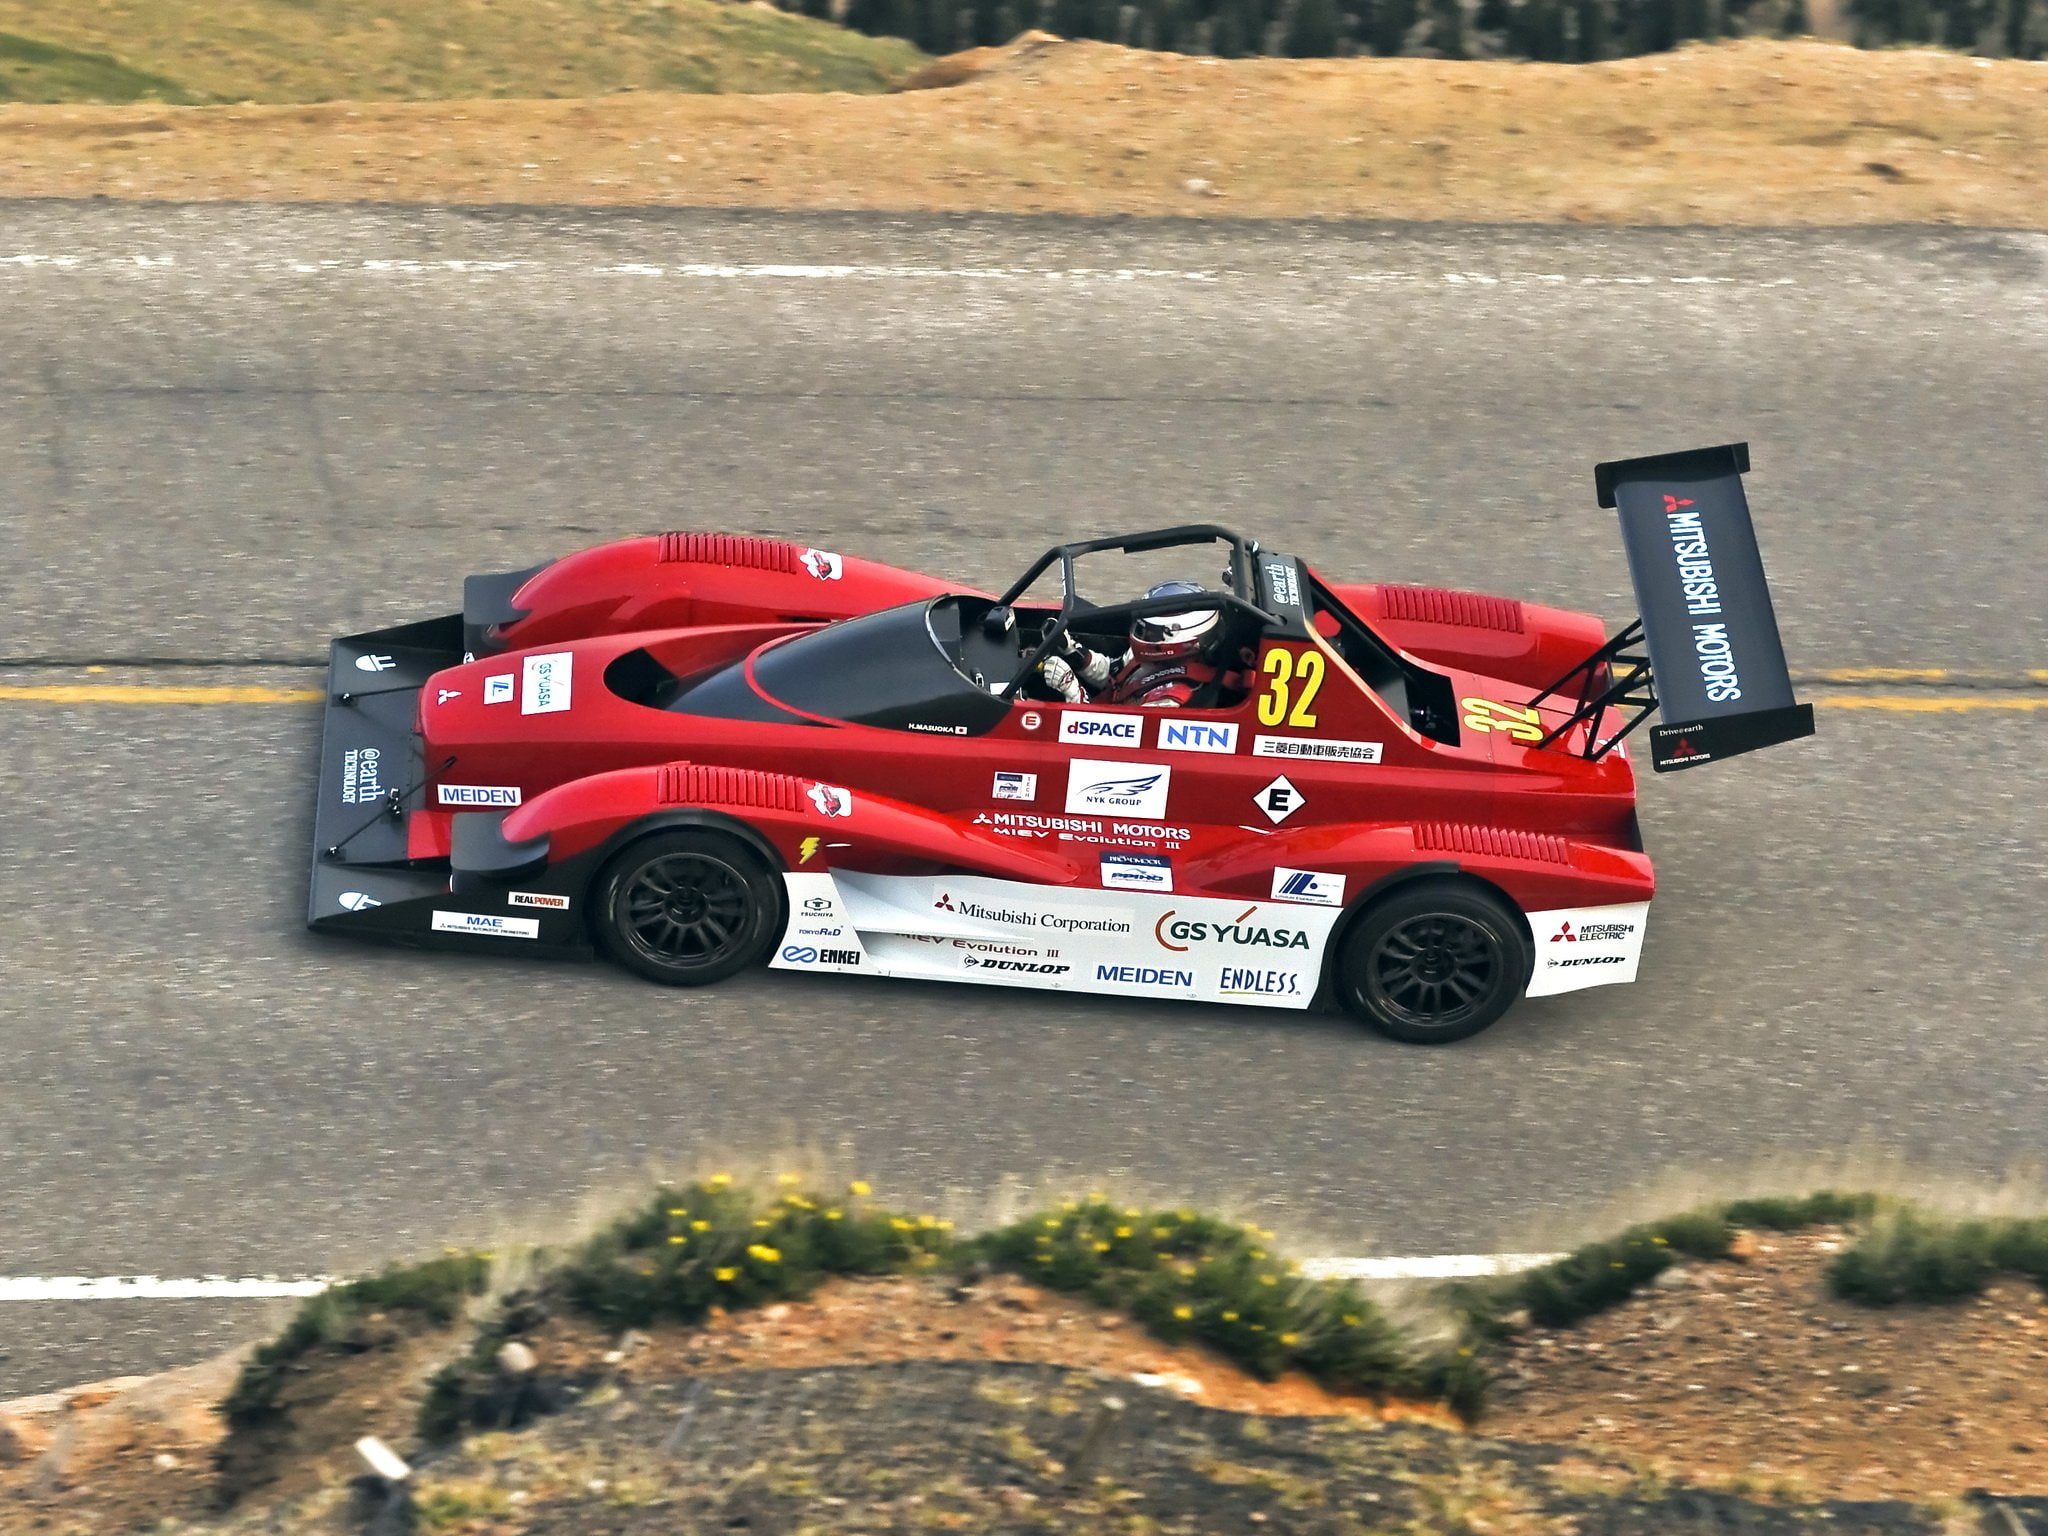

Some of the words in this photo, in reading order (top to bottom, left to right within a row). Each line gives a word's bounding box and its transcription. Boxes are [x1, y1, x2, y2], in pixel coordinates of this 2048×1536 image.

[1667, 511, 1722, 615] MITSUBISHI
[1264, 564, 1289, 604] @earth
[1692, 623, 1742, 703] MOTORS
[1257, 648, 1325, 728] 32
[1025, 715, 1037, 726] E
[1067, 721, 1136, 738] dSPACE
[1461, 697, 1544, 741] 32
[1167, 725, 1229, 748] NTN
[1263, 741, 1375, 760] 三菱自動車販売協会
[343, 749, 358, 804] TECHNOLOGY
[359, 748, 386, 803] @earth
[443, 788, 516, 803] MEIDEN
[1086, 796, 1105, 804] NYK
[1108, 797, 1142, 806] GROUP
[1268, 788, 1291, 812] E
[993, 813, 1102, 833] MITSUBISHI
[1113, 822, 1191, 841] MOTORS
[1058, 832, 1156, 848] Evolution
[1165, 841, 1181, 850] III
[466, 916, 504, 928] MAE
[958, 901, 1037, 926] Mitsubishi
[1040, 914, 1131, 933] Corporation
[1170, 921, 1208, 941] GS
[1211, 923, 1310, 950] YUASA
[1579, 932, 1625, 941] ELECTRIC
[1580, 924, 1634, 933] MITSUBISHI
[819, 948, 861, 966] ENKEI
[952, 939, 1038, 957] Evolution
[1047, 949, 1059, 958] III
[980, 958, 1071, 974] DUNLOP
[1560, 956, 1626, 967] DUNLOP
[1096, 965, 1193, 987] MEIDEN
[1220, 967, 1298, 993] ENDLESS
